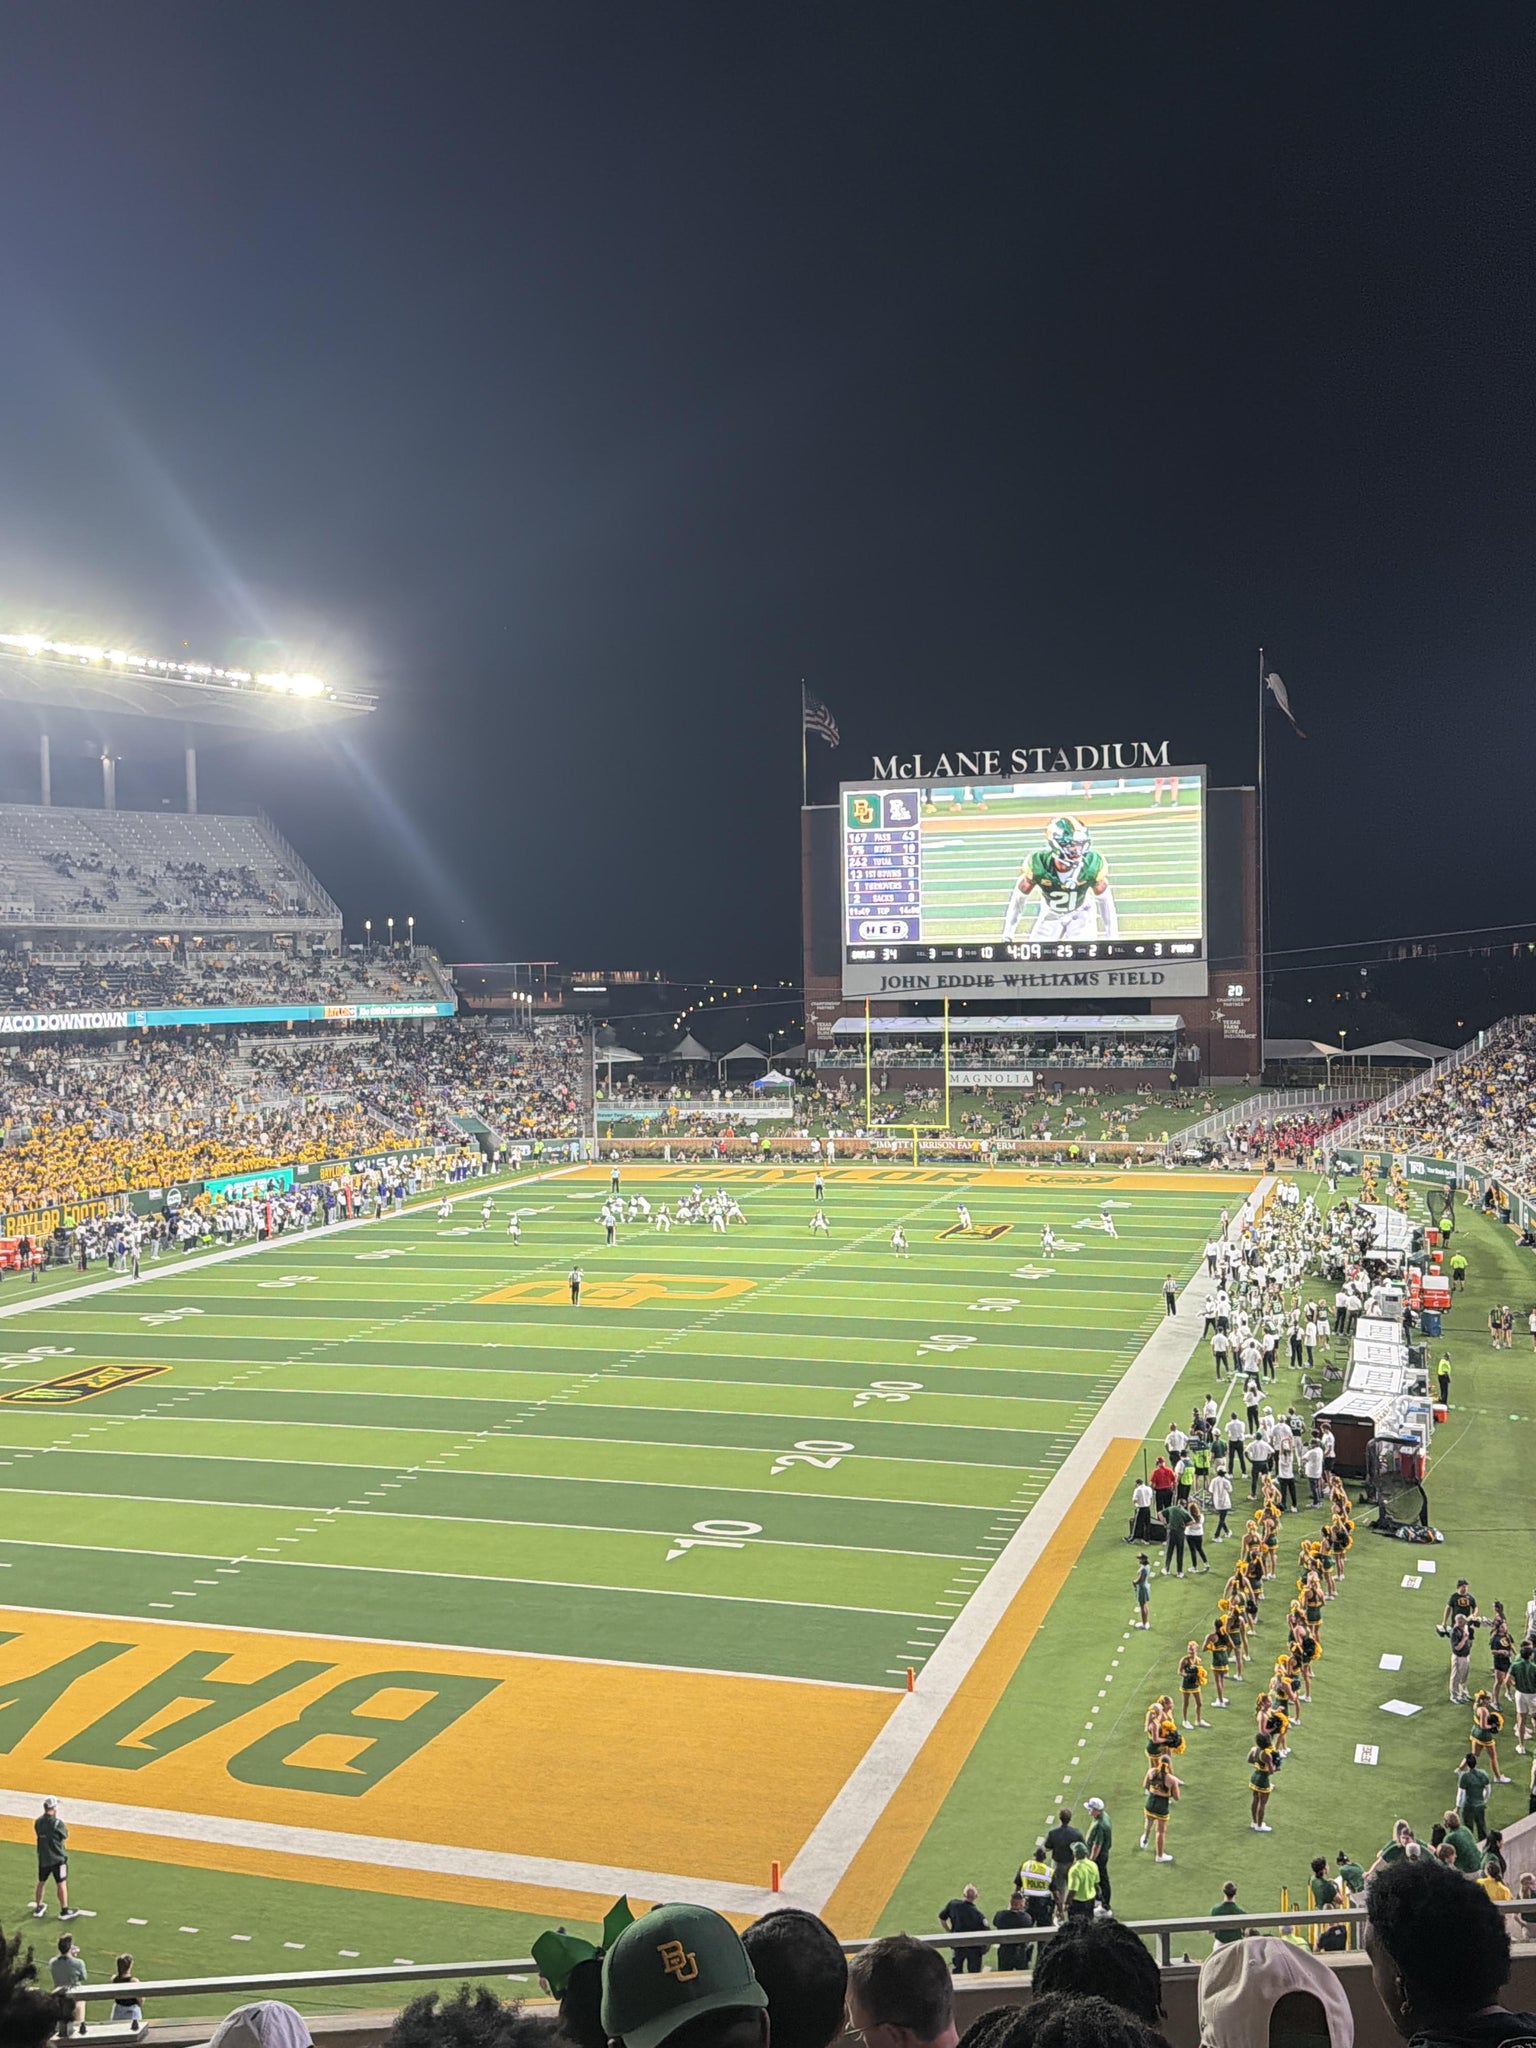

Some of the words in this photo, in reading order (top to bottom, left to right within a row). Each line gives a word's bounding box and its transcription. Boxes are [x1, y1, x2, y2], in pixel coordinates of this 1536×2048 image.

[872, 750, 1001, 780] McLANE
[1011, 741, 1171, 774] STADIUM
[849, 833, 867, 842] 167
[849, 857, 867, 866] 262
[851, 869, 862, 878] 13
[1050, 891, 1077, 911] 21
[882, 948, 897, 960] 34
[928, 948, 936, 960] 3
[981, 946, 993, 959] 10
[1007, 944, 1041, 960] 4:09
[1057, 945, 1073, 957] 25
[1089, 944, 1097, 957] 2
[1154, 943, 1162, 956] 3
[880, 975, 930, 991] JOHN
[937, 974, 995, 988] EDDIE
[1003, 973, 1099, 987] WILLIAMS
[1108, 972, 1165, 985] FIELD
[38, 1012, 127, 1030] DOWNTOWN
[950, 1074, 1030, 1083] MAGNOLIA
[659, 1168, 983, 1184] BAYLOR
[6, 1207, 60, 1240] BAYLOR
[966, 1298, 1021, 1313] 50
[919, 1334, 978, 1352] 40
[855, 1381, 924, 1402] 30
[775, 1440, 855, 1469] 20
[673, 1519, 763, 1549] 10
[656, 1940, 699, 1982] BU
